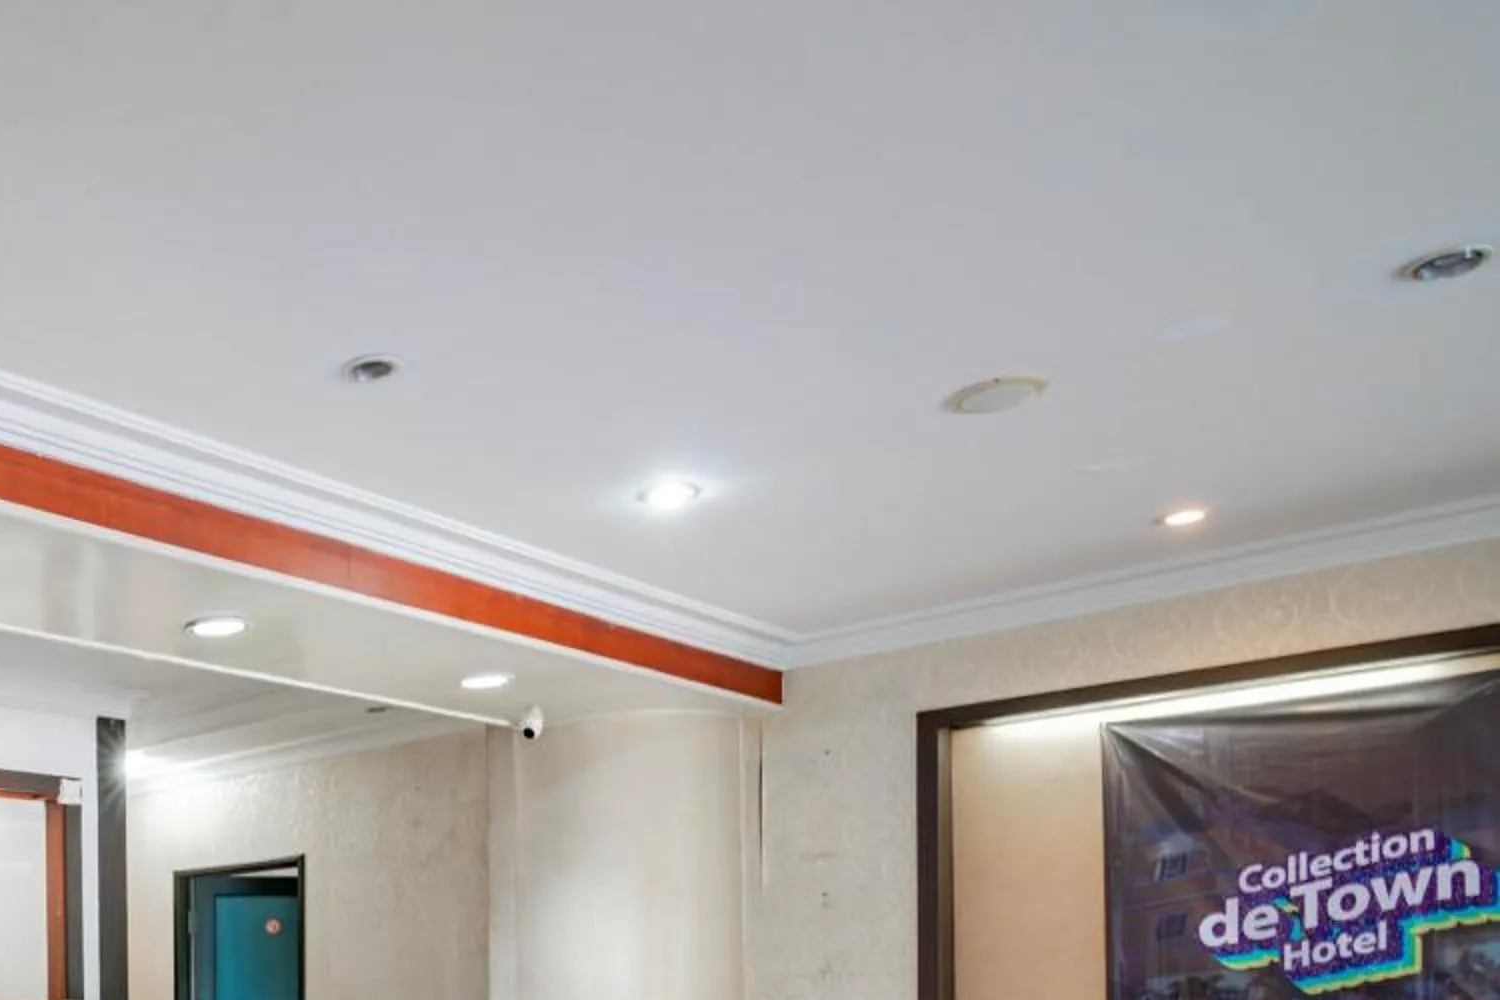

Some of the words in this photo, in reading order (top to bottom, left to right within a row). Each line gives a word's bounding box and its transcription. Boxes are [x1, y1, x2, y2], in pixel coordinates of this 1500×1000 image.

[1238, 828, 1435, 893] Collection
[1199, 897, 1279, 948] de
[1290, 858, 1481, 930] Town
[1283, 919, 1387, 972] Hotel
